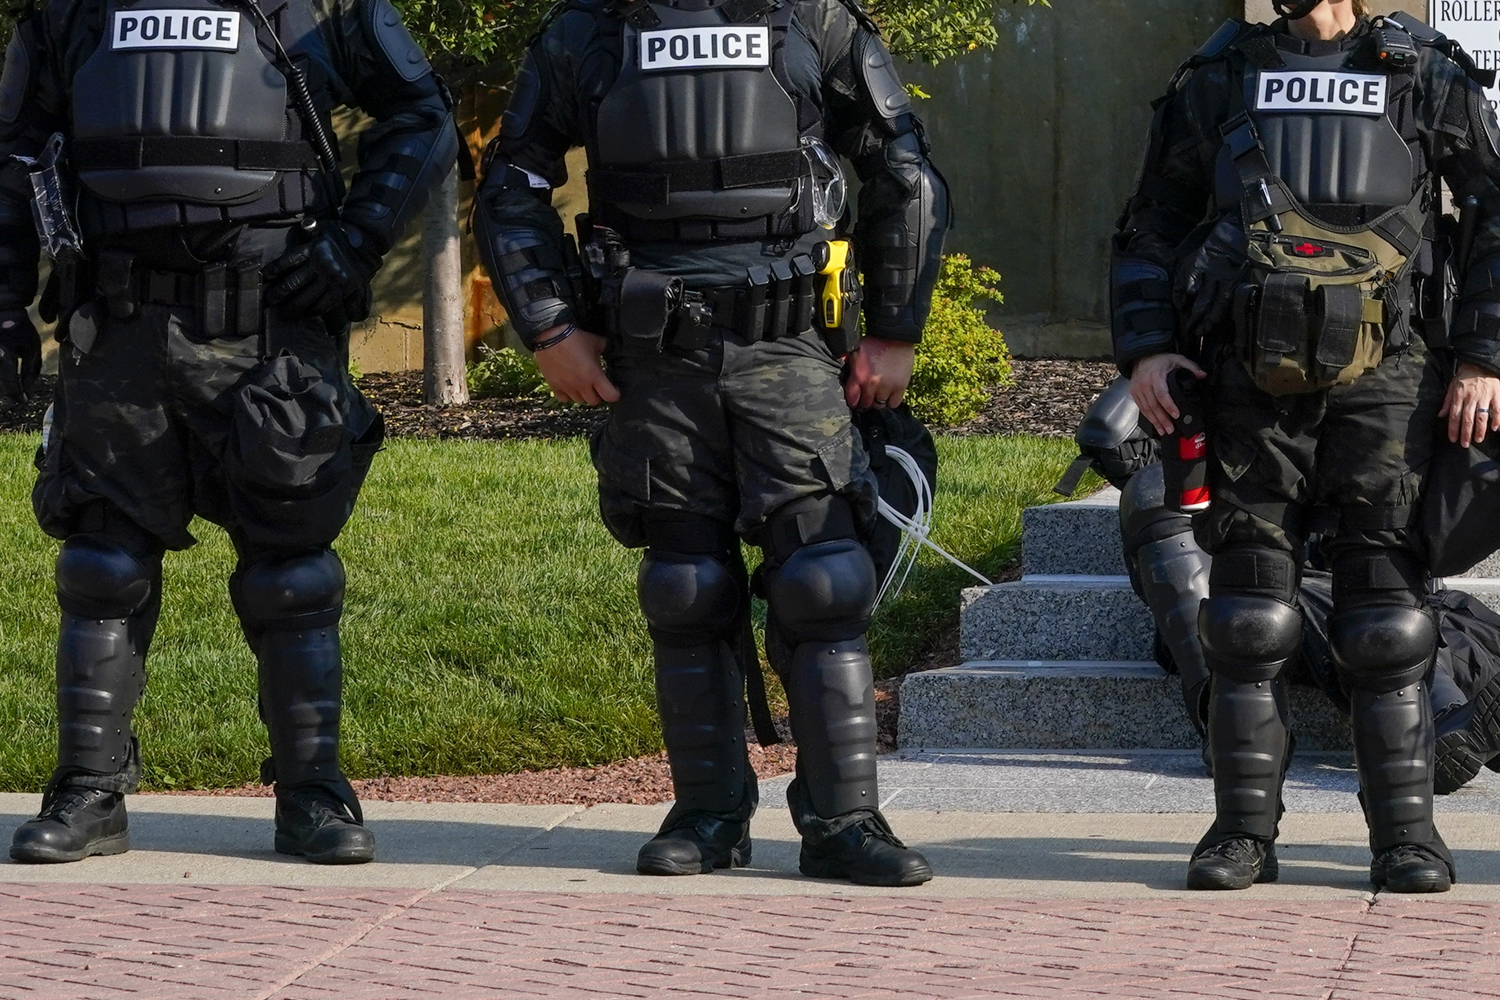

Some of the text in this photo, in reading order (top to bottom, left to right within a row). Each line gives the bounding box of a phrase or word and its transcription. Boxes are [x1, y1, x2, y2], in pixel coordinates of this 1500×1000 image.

[118, 15, 232, 43] POLICE
[647, 33, 762, 63] POLICE
[1263, 77, 1380, 107] POLICE
